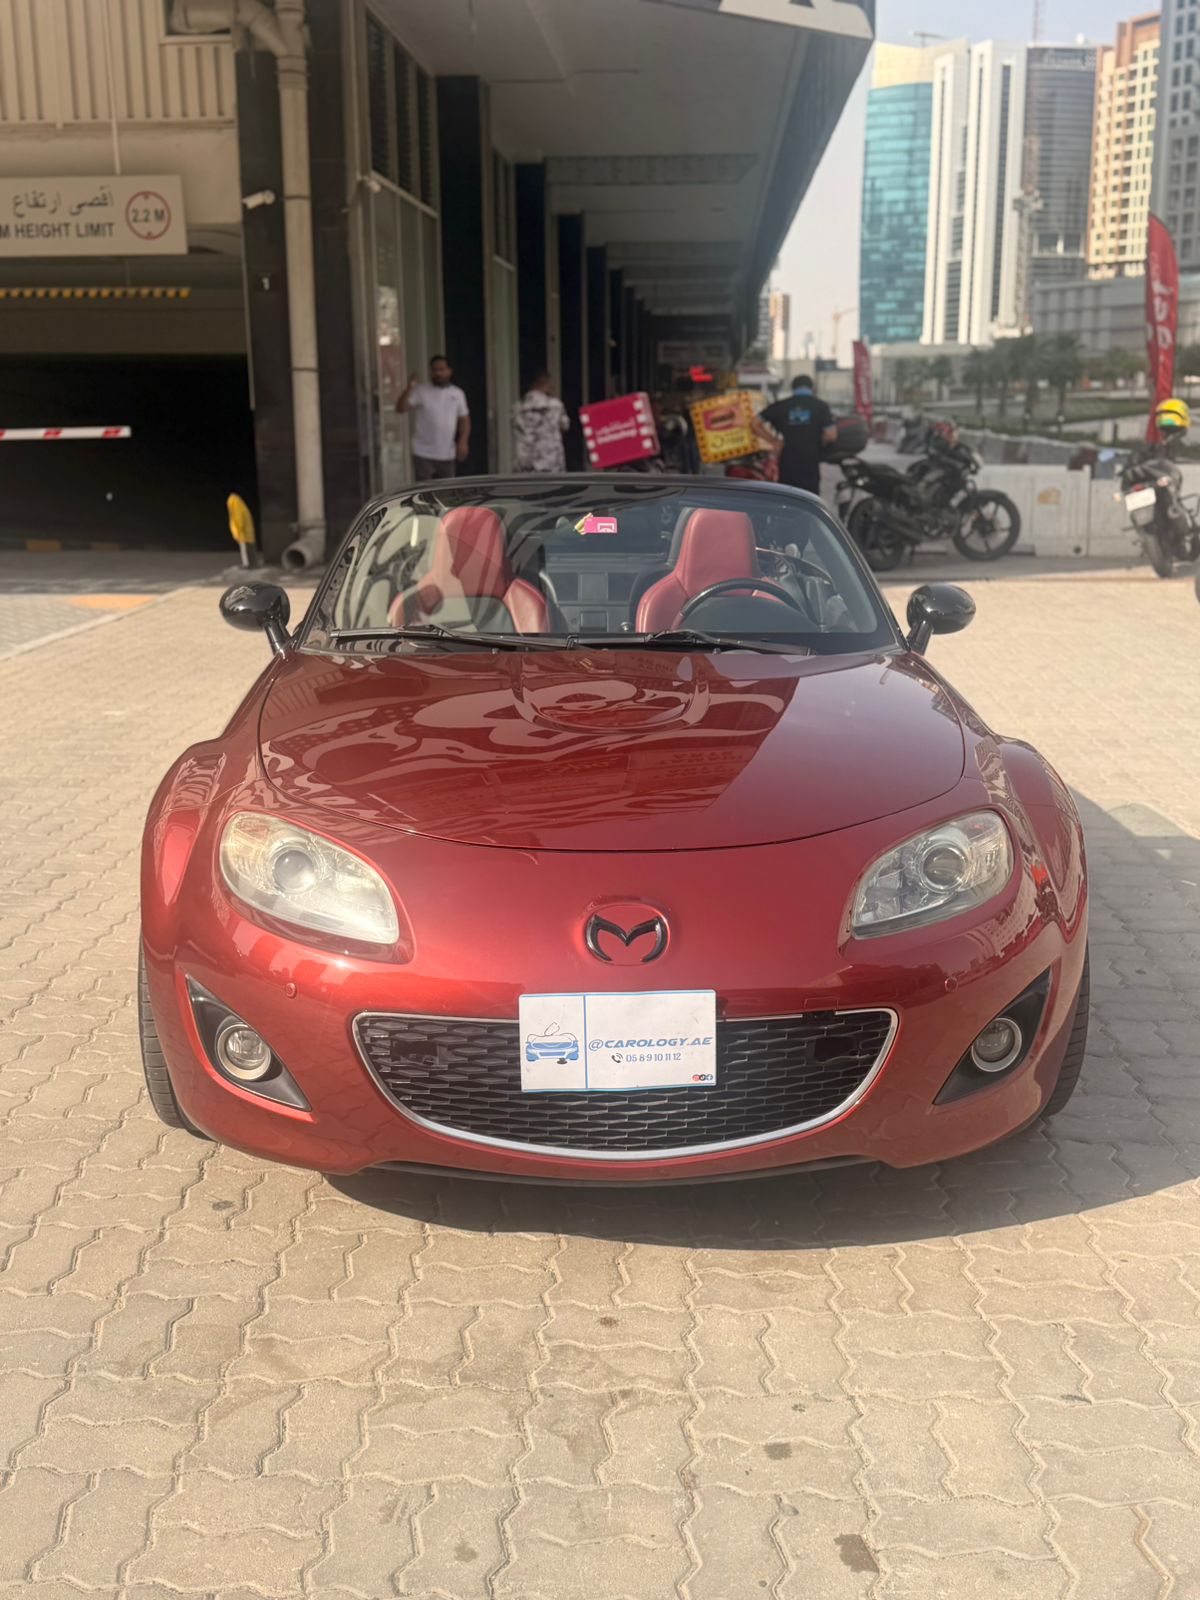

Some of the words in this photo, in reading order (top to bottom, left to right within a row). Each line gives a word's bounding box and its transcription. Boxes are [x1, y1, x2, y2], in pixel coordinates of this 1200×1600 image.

[131, 208, 151, 222] 2.2
[154, 208, 165, 222] M
[14, 222, 71, 239] HEIGHT
[76, 222, 115, 238] LIMIT
[588, 1037, 713, 1052] @CAROLOGY.AE
